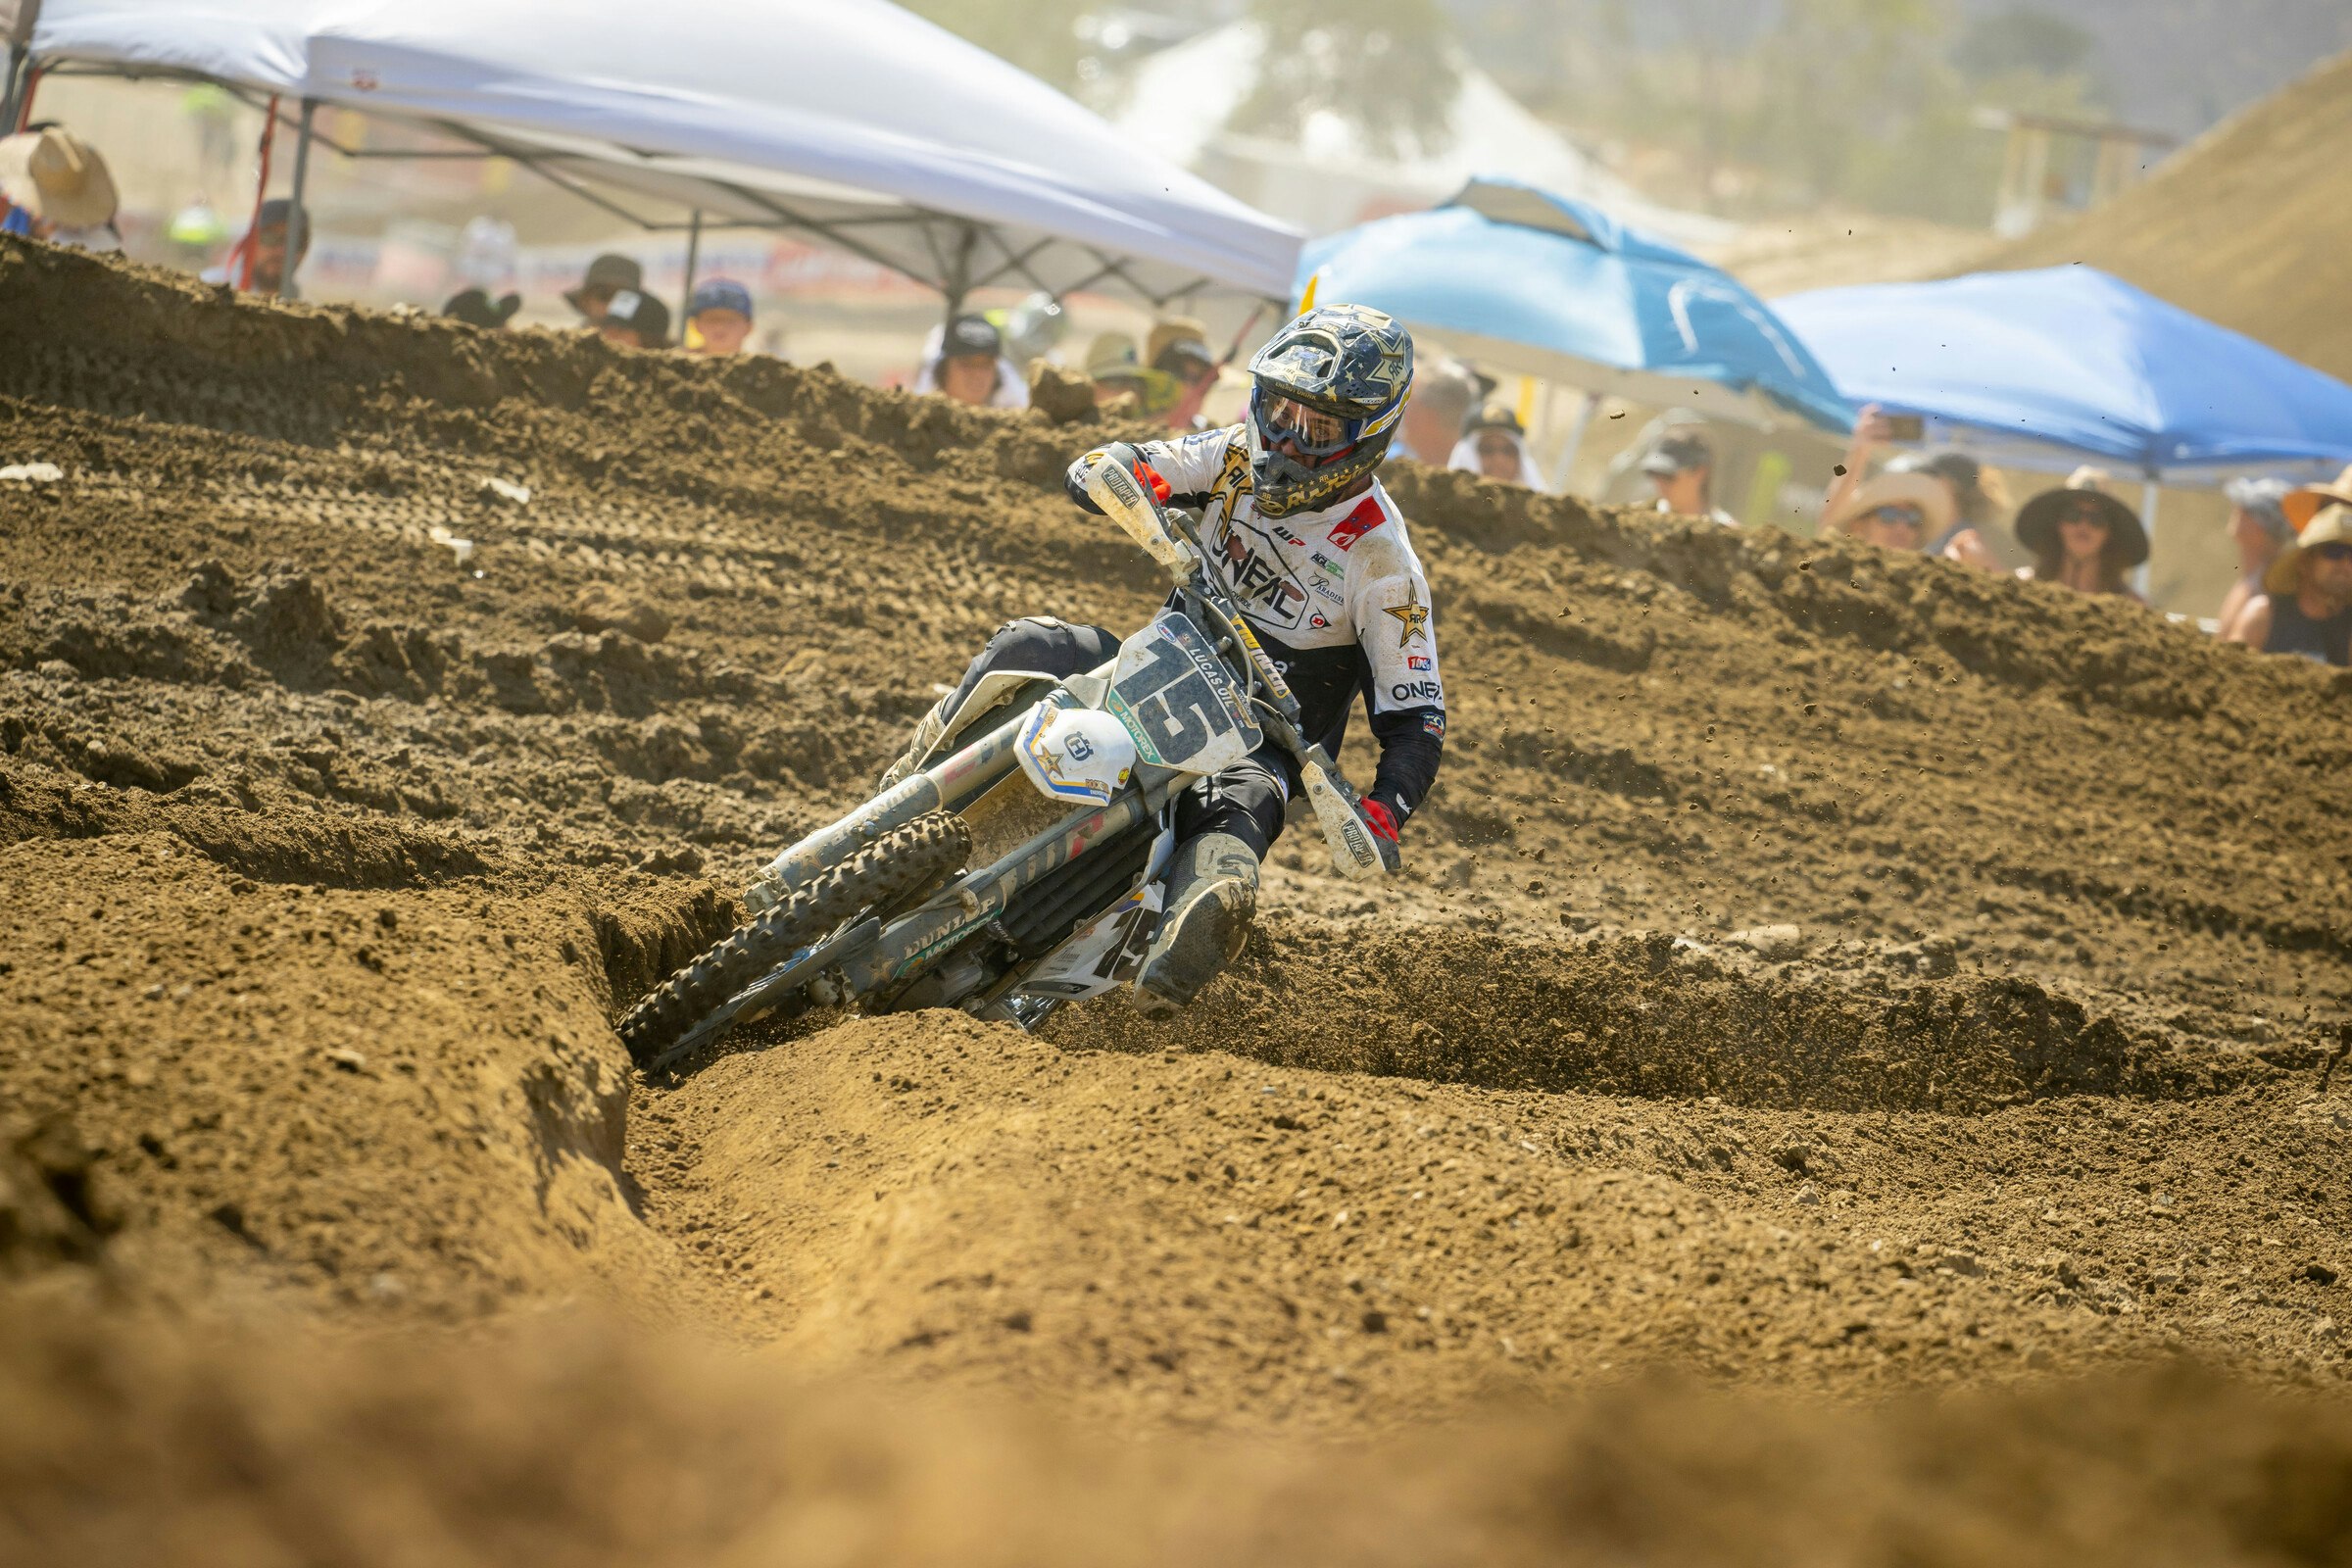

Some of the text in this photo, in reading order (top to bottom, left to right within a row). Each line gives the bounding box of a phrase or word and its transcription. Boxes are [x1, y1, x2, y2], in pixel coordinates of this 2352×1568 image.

[1296, 389, 1317, 401] DRINK
[1106, 468, 1137, 506] PROTAPER
[1311, 553, 1328, 568] AGL
[1189, 648, 1235, 709] LUCAS OIL
[1392, 680, 1443, 703] O'NE
[1114, 638, 1233, 764] 15
[1119, 710, 1156, 760] MOTOREX
[1345, 823, 1374, 863] PROTAPER
